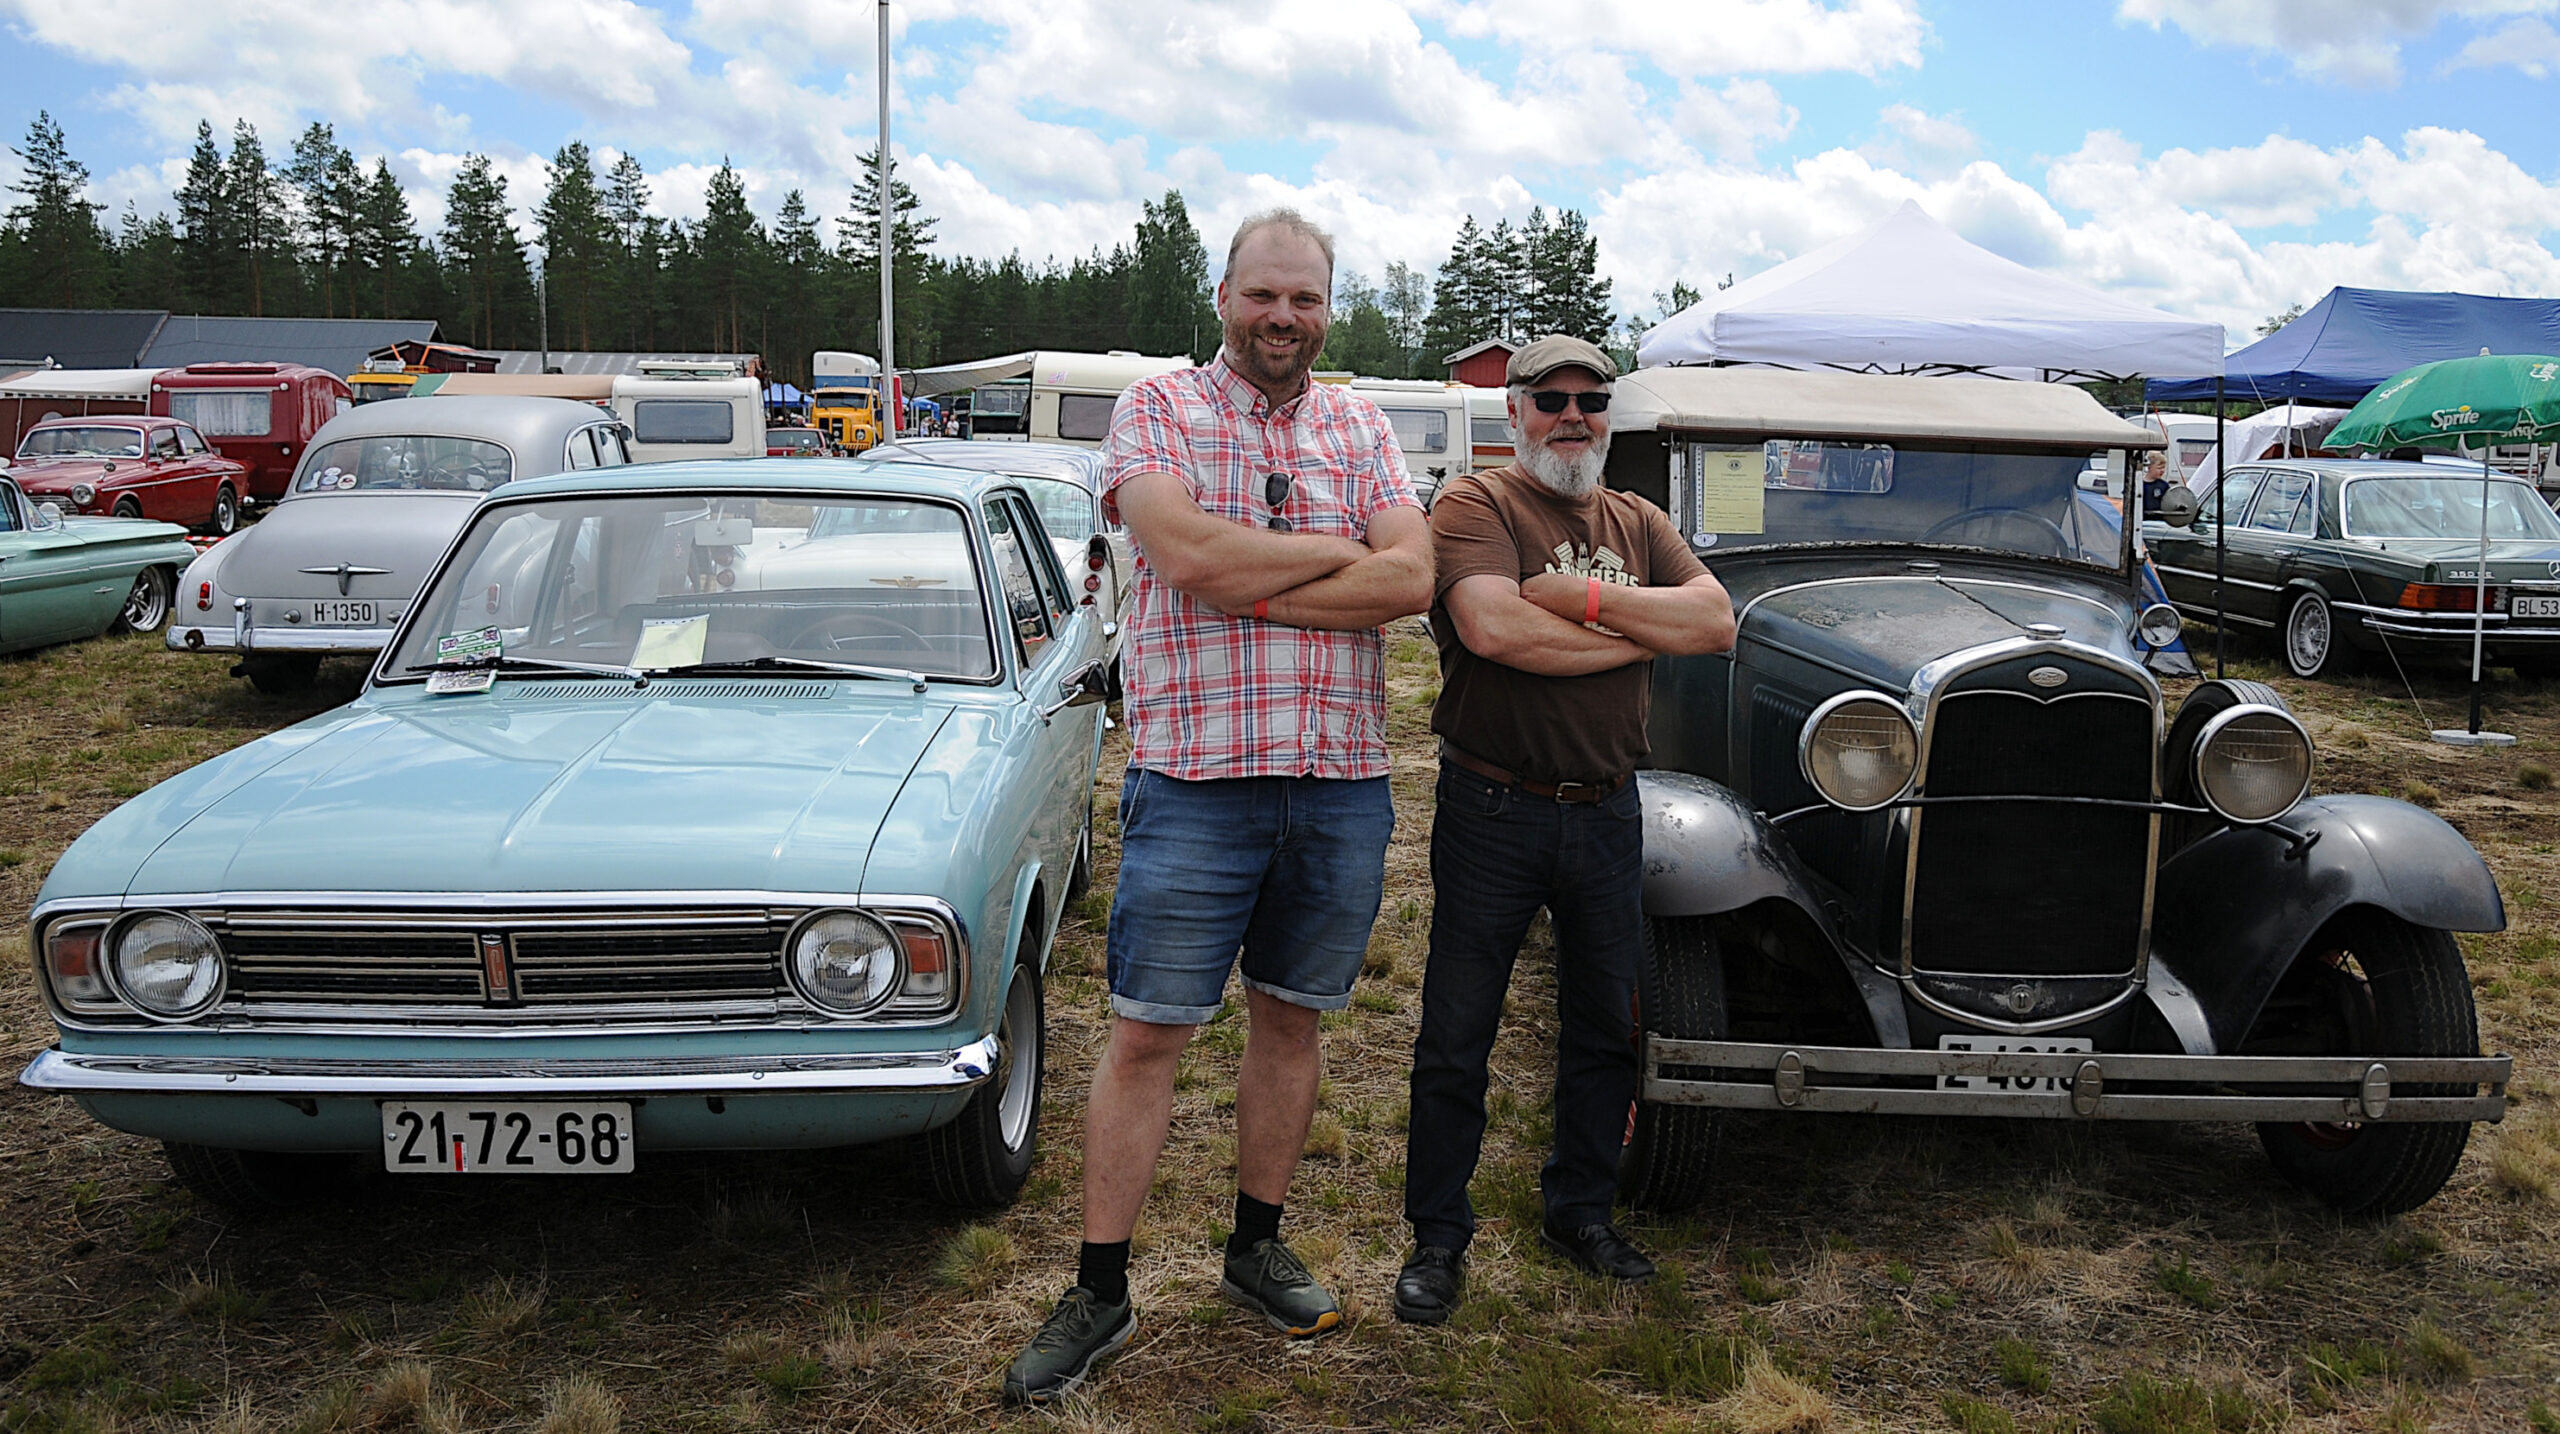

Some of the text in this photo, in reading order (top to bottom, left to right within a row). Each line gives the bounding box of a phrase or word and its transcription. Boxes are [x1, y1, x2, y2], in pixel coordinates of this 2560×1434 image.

[2430, 408, 2480, 431] Sprite
[314, 602, 371, 622] H-1350
[2517, 600, 2537, 616] BL
[395, 1110, 620, 1166] 21-72-68
